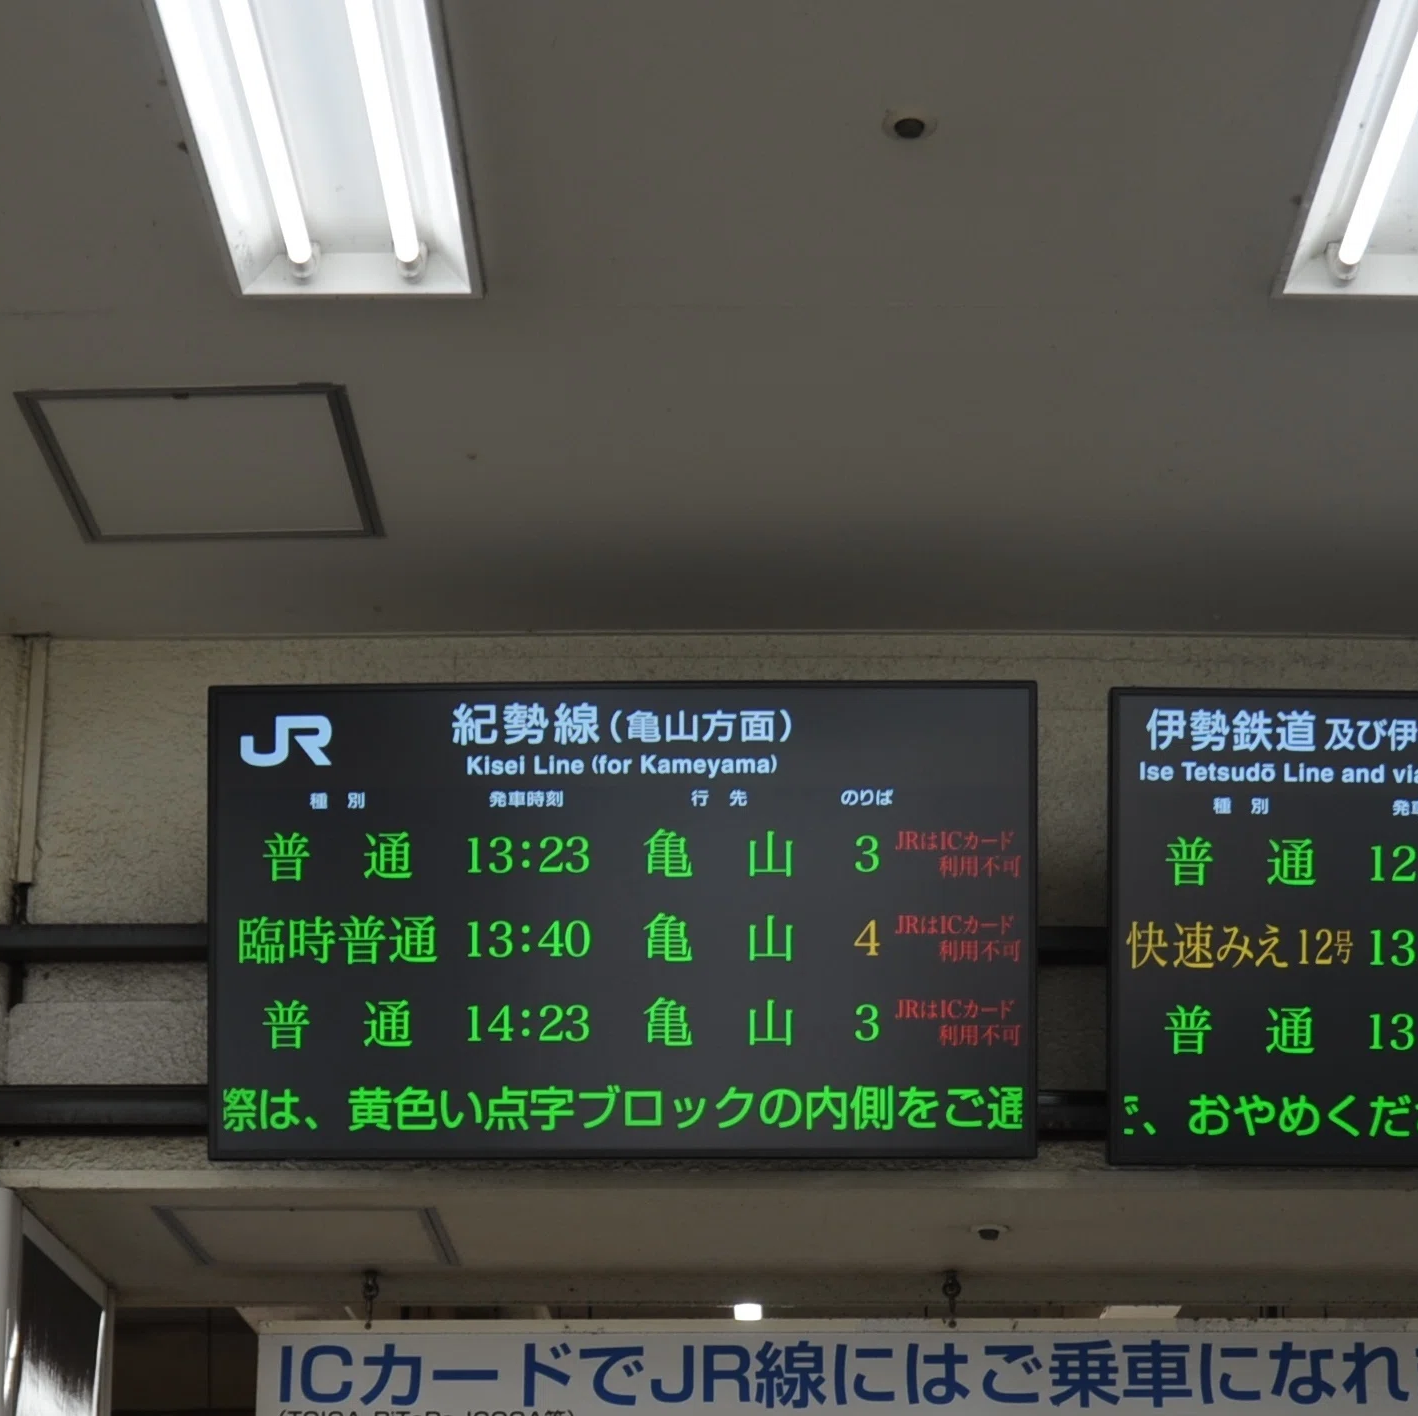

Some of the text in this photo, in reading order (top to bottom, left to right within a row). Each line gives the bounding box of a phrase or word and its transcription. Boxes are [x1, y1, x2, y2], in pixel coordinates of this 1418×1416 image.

[240, 715, 332, 767] JR
[467, 754, 777, 778] Kisei Line (for Kameyama)
[1140, 761, 1174, 781] Ise
[1181, 761, 1276, 782] Tetsudō
[1284, 763, 1334, 783] Line
[1341, 764, 1385, 783] and
[489, 789, 893, 807] 発車時刻 のりば
[895, 831, 1015, 851] JRはICカード
[468, 835, 879, 873] 13:23 3
[938, 855, 1022, 878] 利用不可
[894, 915, 1014, 935] JRはICカード
[239, 915, 880, 964] 臨時普通 13:40 4
[938, 939, 1022, 963] 利用不可
[894, 999, 1015, 1020] JRはICカード
[468, 1004, 879, 1042] 14:23 3
[938, 1023, 1022, 1046] 利用不可
